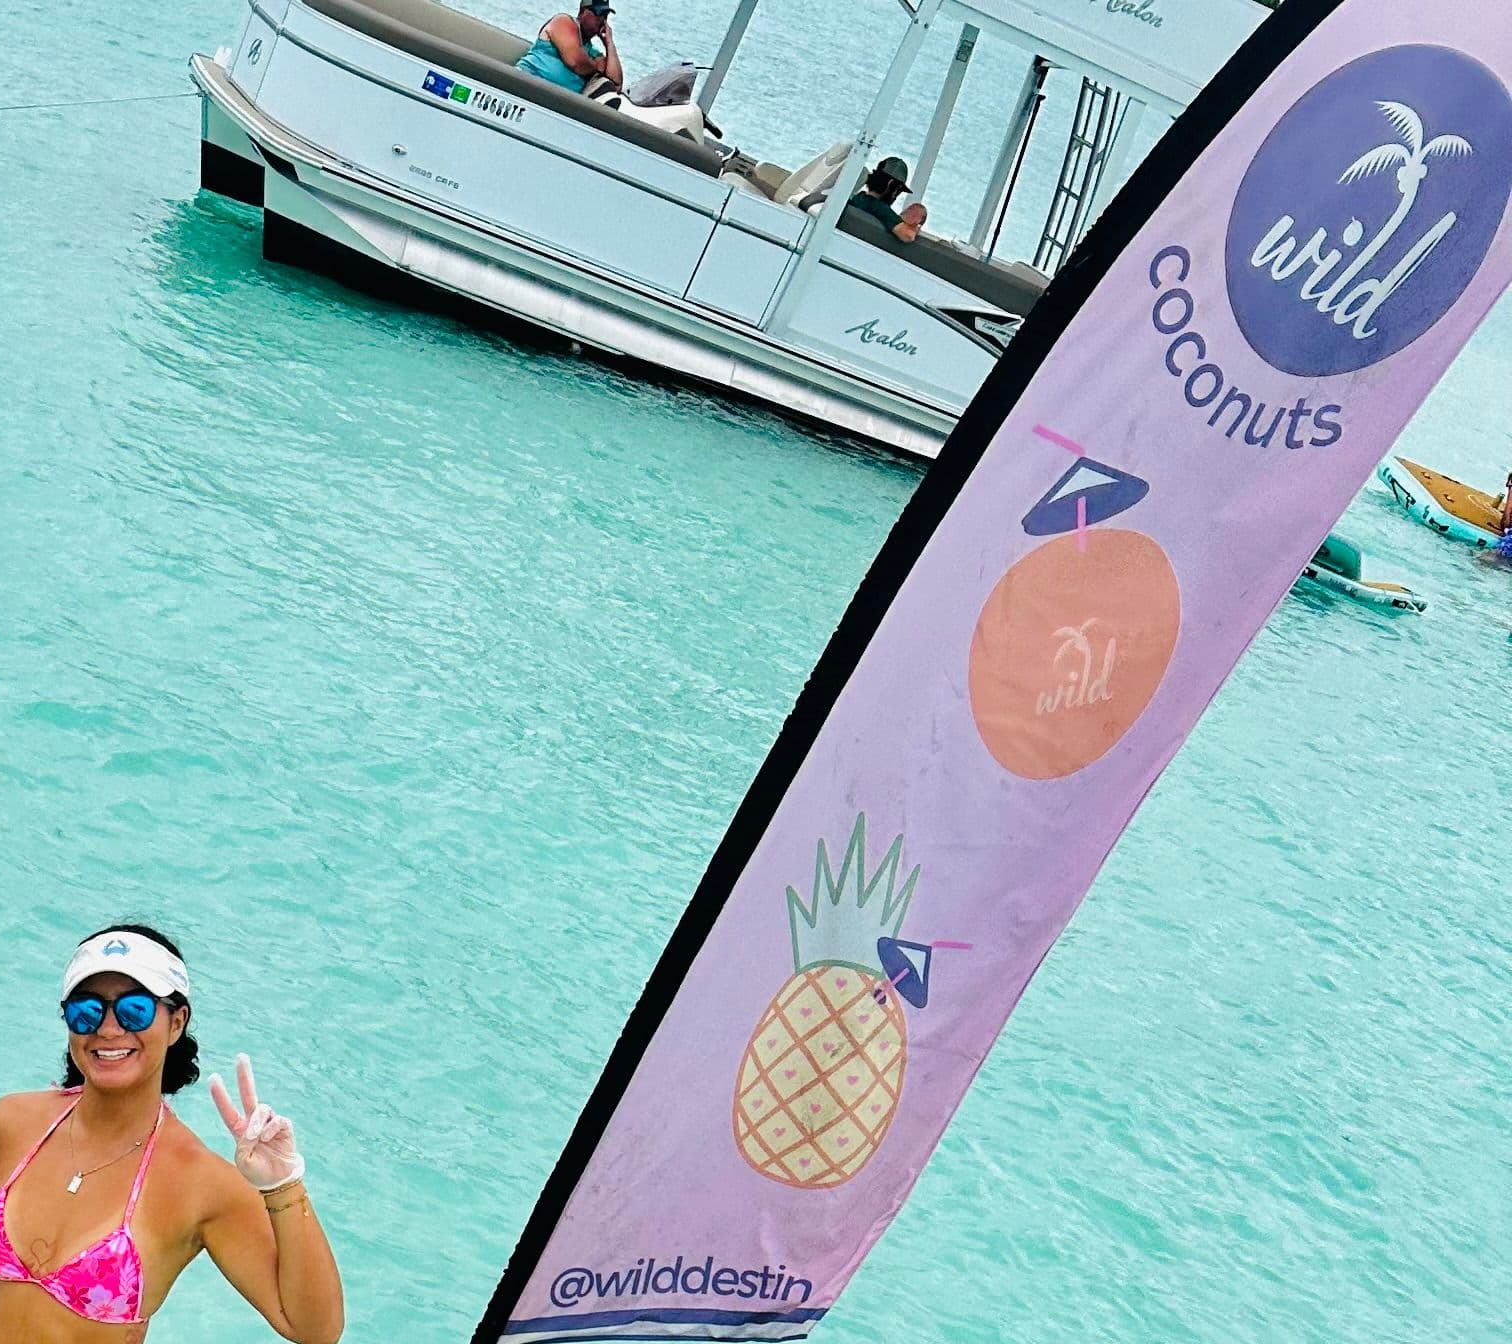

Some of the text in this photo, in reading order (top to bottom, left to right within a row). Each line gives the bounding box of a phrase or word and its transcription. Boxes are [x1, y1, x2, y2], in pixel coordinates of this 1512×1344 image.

[1251, 165, 1458, 340] wild
[844, 319, 918, 355] Avalon
[1149, 245, 1343, 450] coconuts
[1036, 634, 1117, 716] wild
[550, 1256, 813, 1308] @wilddestin
